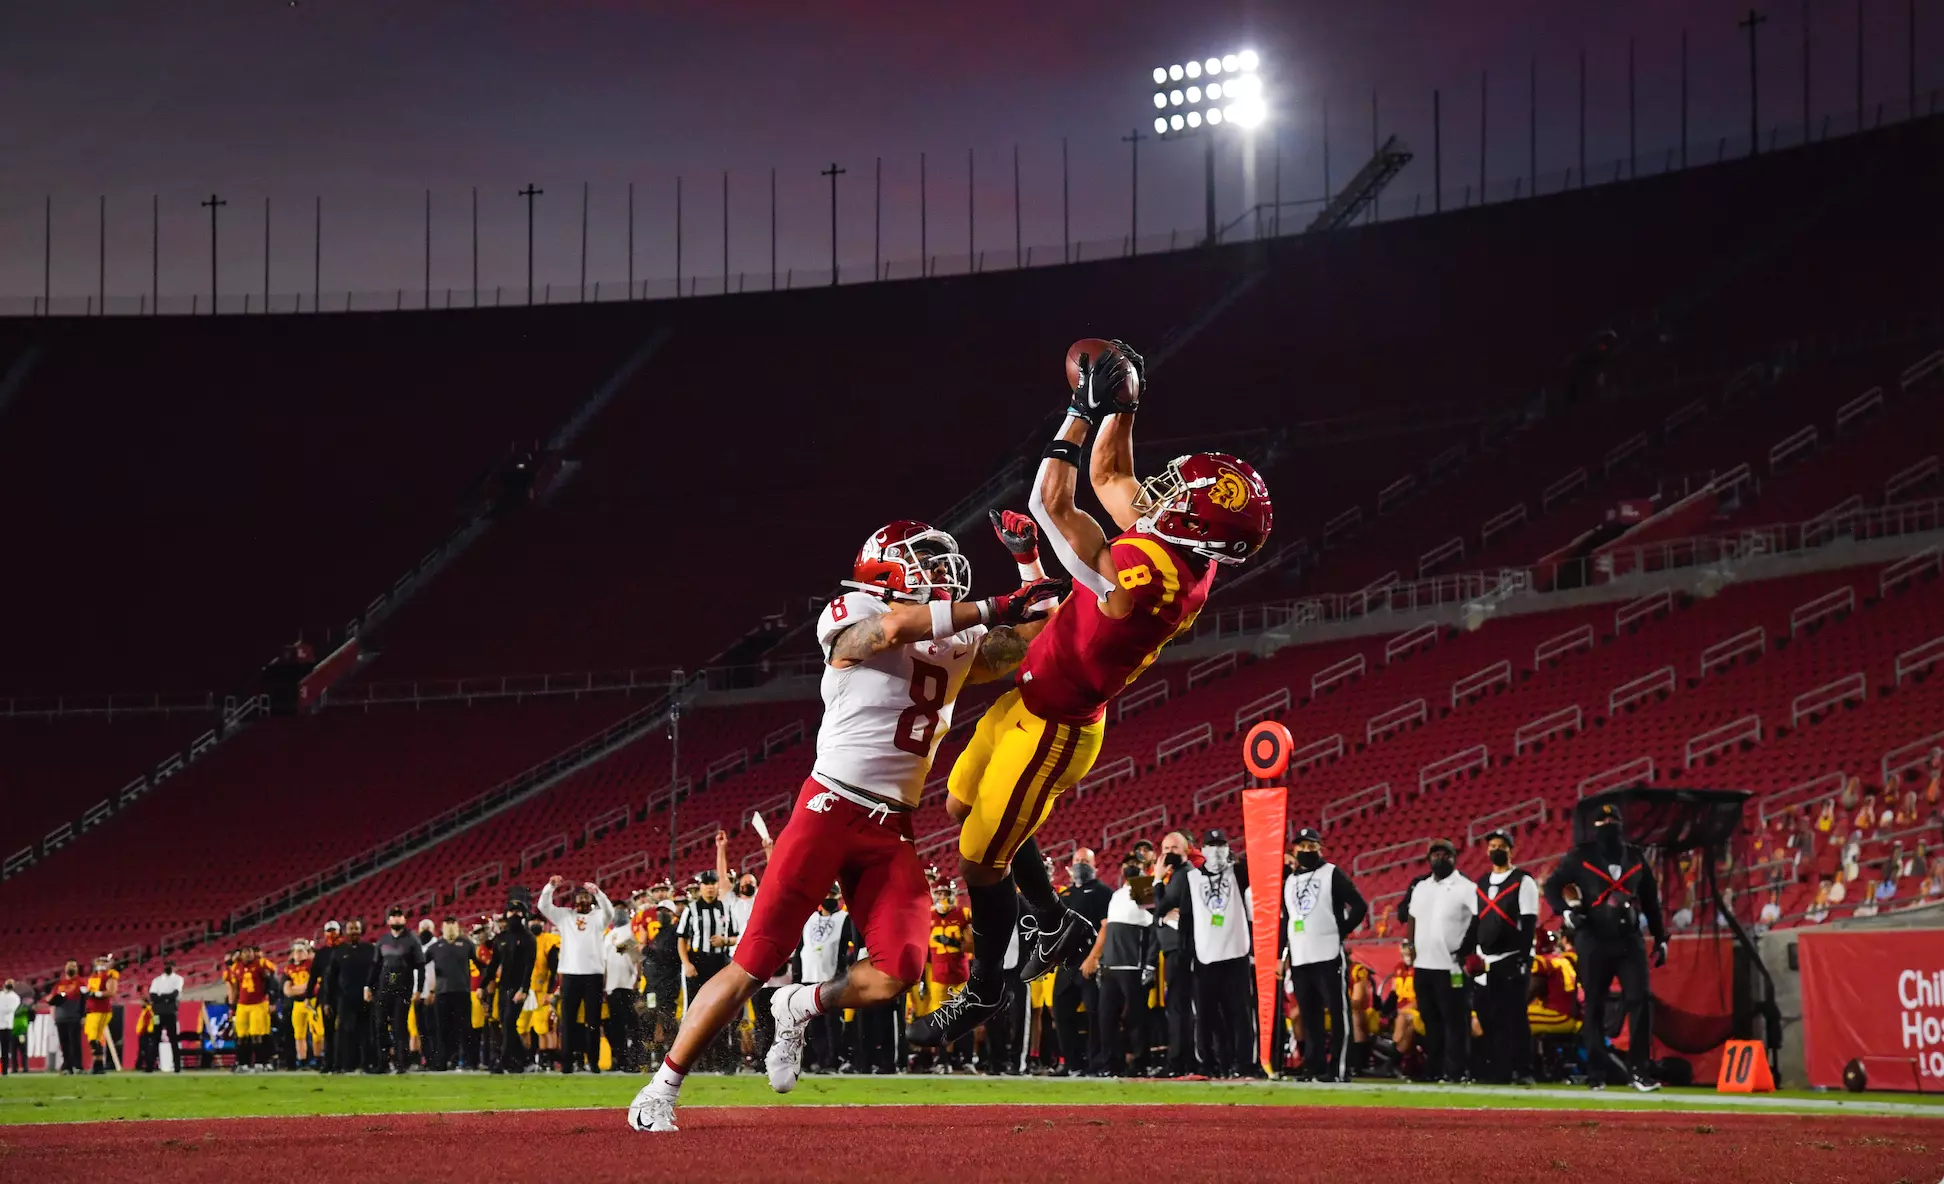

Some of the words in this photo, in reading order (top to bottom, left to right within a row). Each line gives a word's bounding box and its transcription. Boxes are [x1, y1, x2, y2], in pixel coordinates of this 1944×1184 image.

[1118, 564, 1152, 590] 8
[831, 596, 848, 622] 8
[894, 655, 948, 757] 8
[1725, 1045, 1754, 1084] 10
